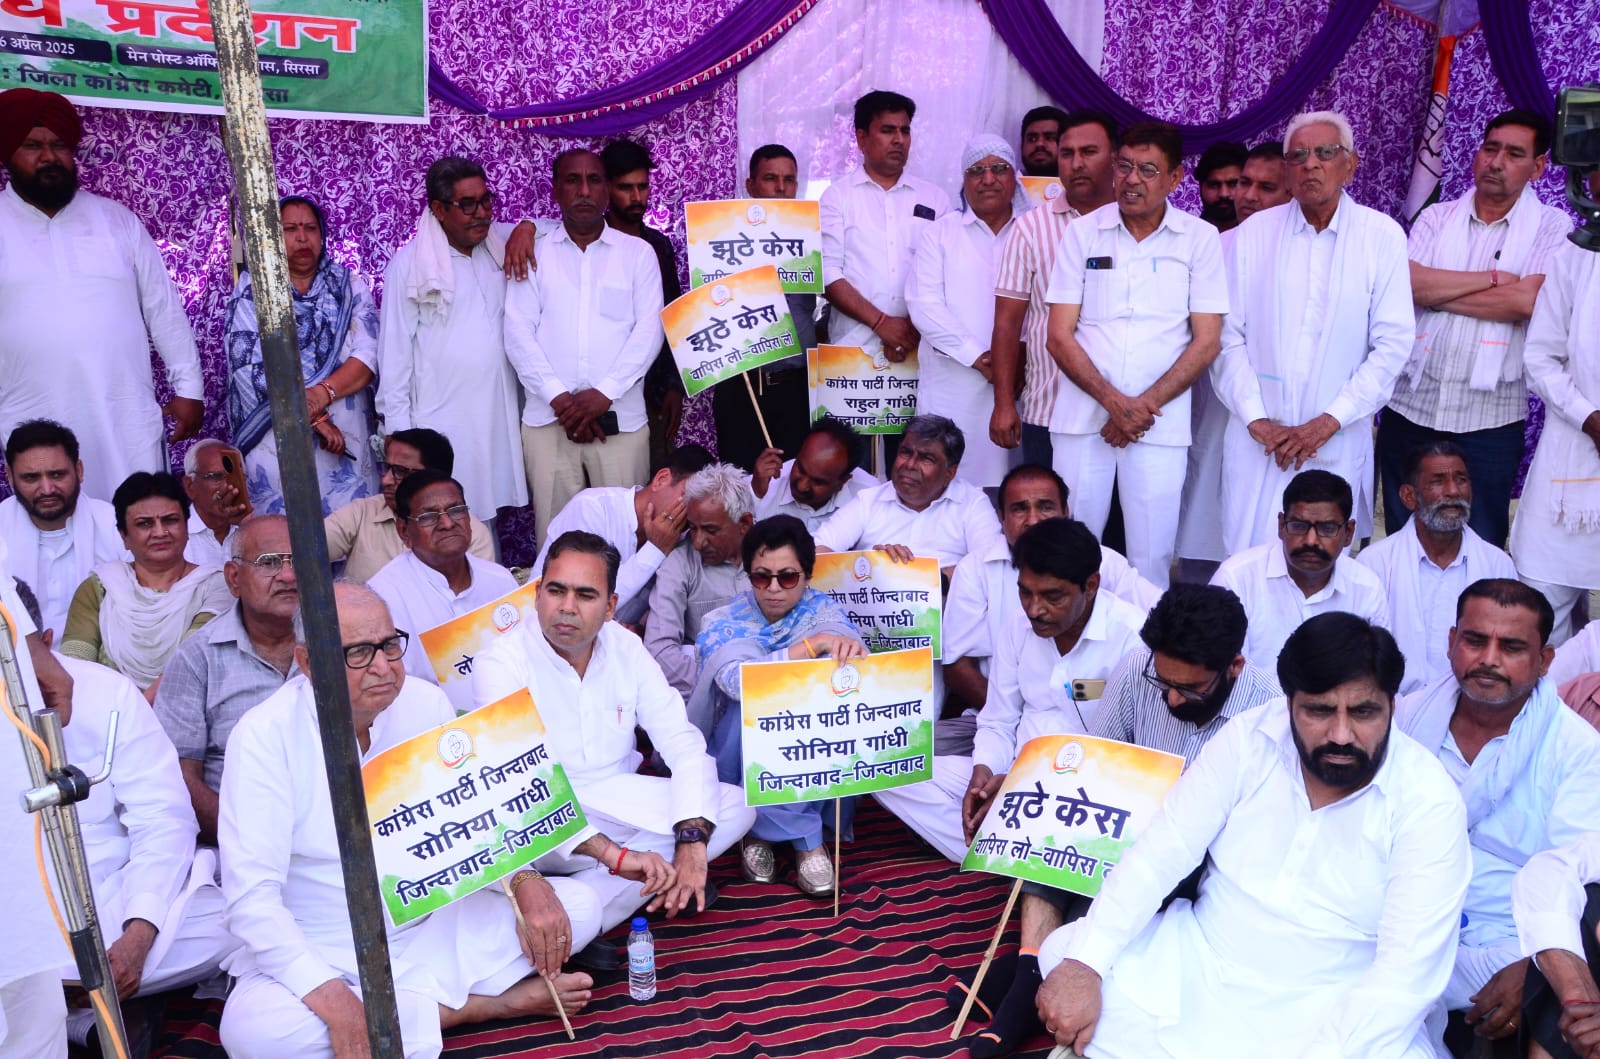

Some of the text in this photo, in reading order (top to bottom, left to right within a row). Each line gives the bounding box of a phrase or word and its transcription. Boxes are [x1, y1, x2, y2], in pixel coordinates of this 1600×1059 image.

[10, 34, 42, 51] अप्रैल
[46, 41, 76, 54] 2025
[127, 47, 148, 63] मेन
[151, 49, 182, 64] पोस्ट
[187, 54, 219, 68] ऑफि
[284, 61, 320, 75] सिरसा
[18, 63, 77, 87] जिला
[83, 72, 150, 94] कांग्रेस
[709, 232, 804, 265] झूठे केस
[801, 268, 814, 282] लो
[686, 304, 778, 352] झूठे केस
[690, 357, 723, 380] वापिस
[781, 333, 793, 345] लो
[825, 375, 919, 389] कांग्रेस पार्टी जिन्दा
[844, 394, 917, 413] राहुल गांधी
[848, 587, 868, 604] पार्टी
[871, 587, 929, 604] जिन्दाबाद
[847, 609, 915, 628] निया गांधी
[758, 699, 922, 732] कांग्रेस पार्टी जिन्दाबाद
[779, 726, 908, 762] सोनिया गांधी
[374, 744, 549, 837] कांग्रेस पार्टी जिन्दाबाद
[407, 777, 551, 860] सोनिया गांधी
[999, 781, 1131, 839] झूठे केस
[975, 833, 1008, 856] वापिस
